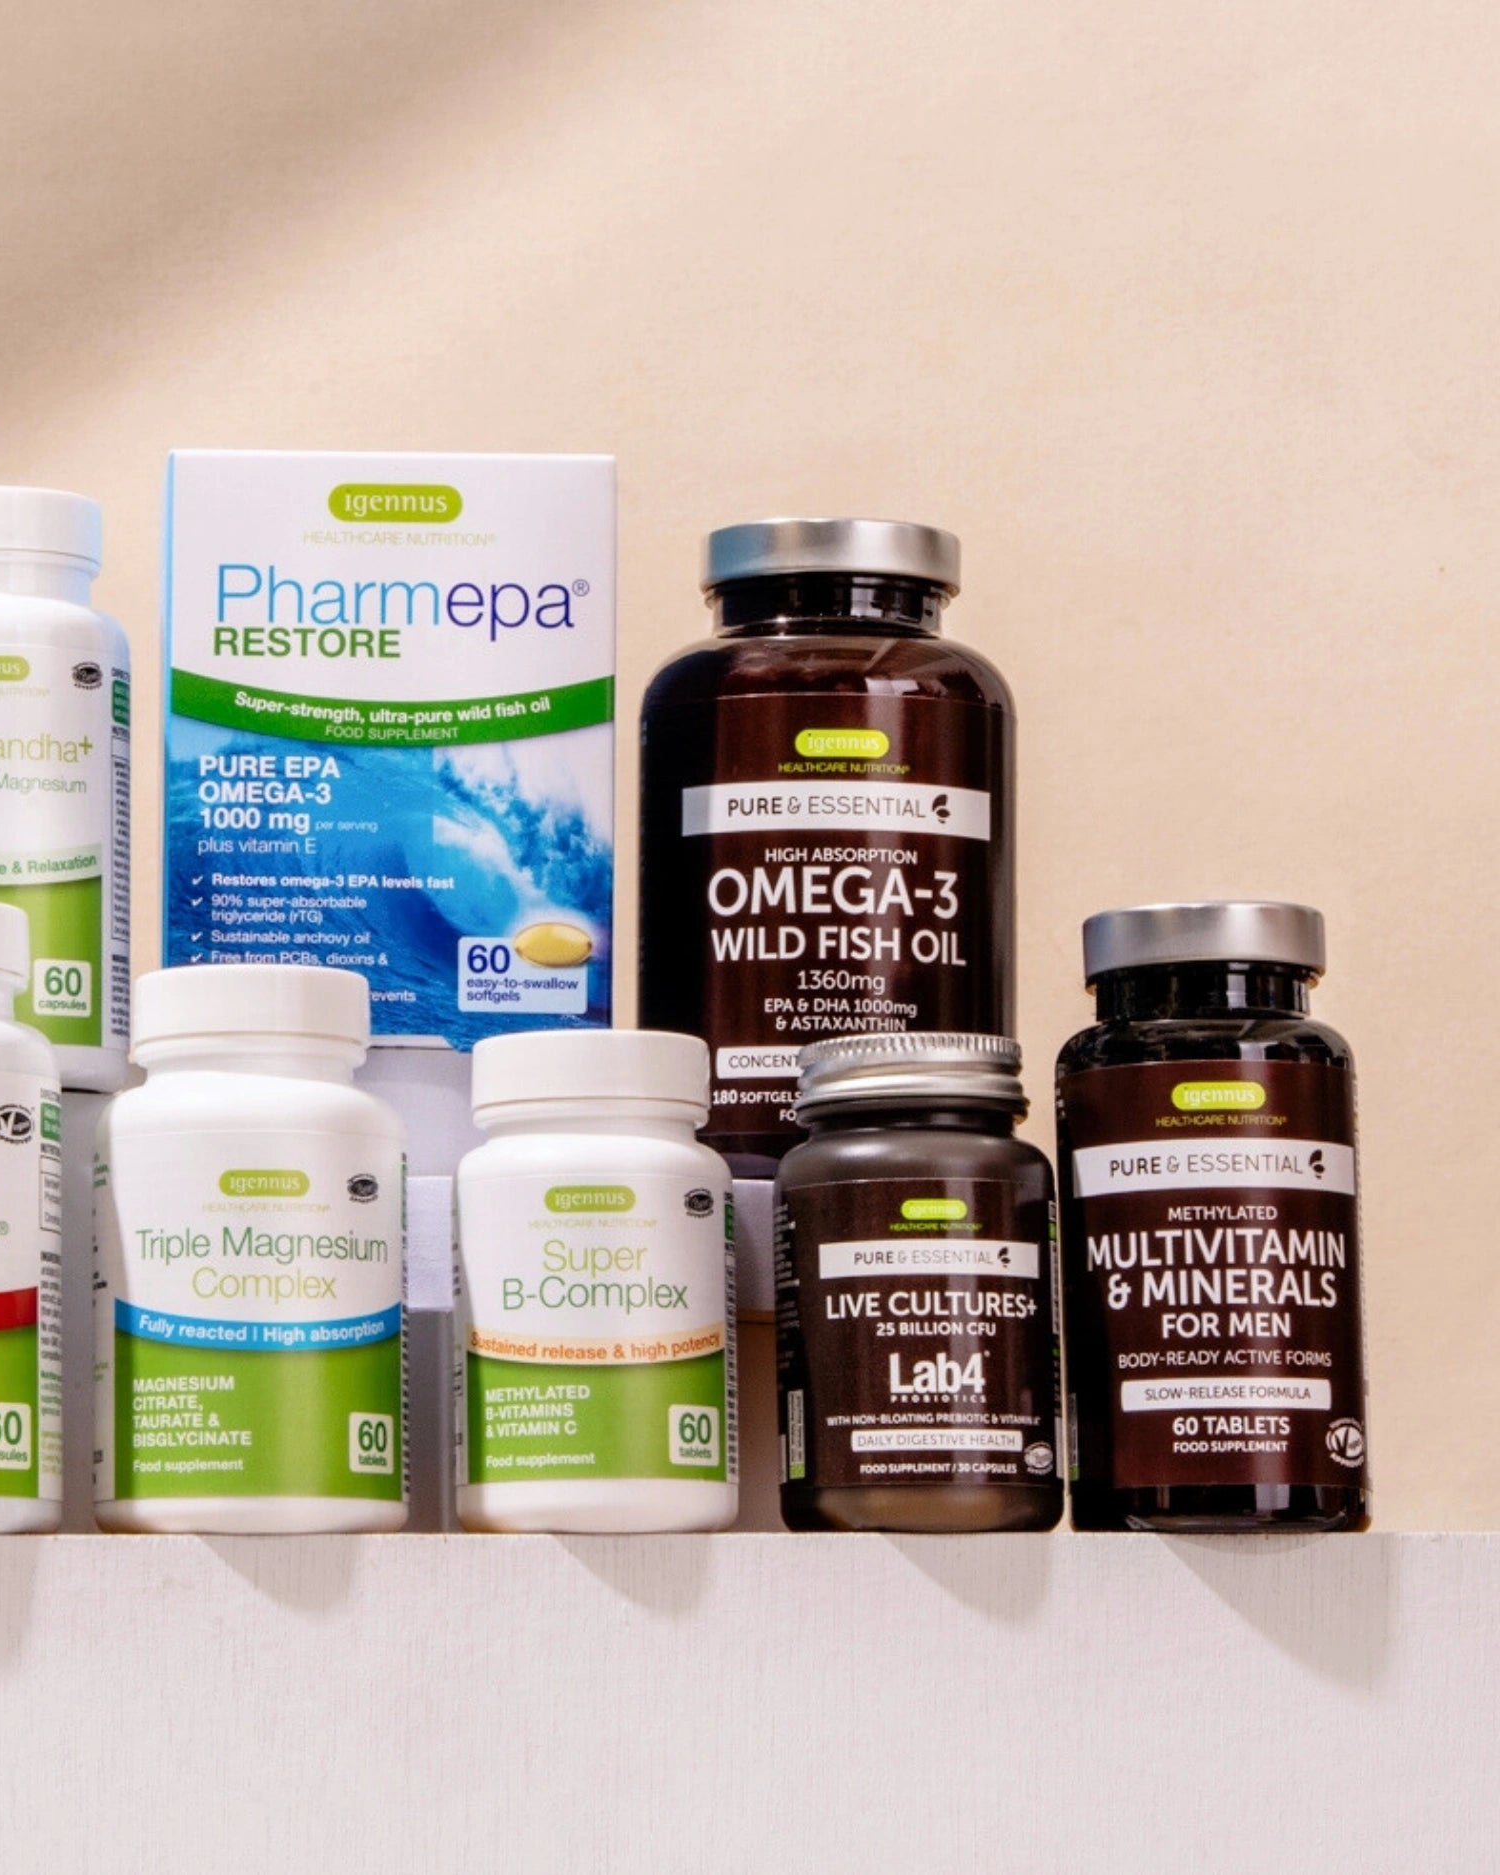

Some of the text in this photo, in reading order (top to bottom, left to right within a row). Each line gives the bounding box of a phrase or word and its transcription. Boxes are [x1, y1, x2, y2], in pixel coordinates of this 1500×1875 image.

[345, 490, 448, 516] igennus
[213, 628, 400, 658] RESTORE
[457, 696, 550, 720] wild fish oil
[326, 726, 458, 739] FOOD SUPPLEMENT
[200, 755, 340, 778] PURE EPA
[199, 781, 331, 804] OMEGA-3
[728, 796, 926, 818] PURE ESSENTIAL
[200, 808, 310, 834] 1000 mg
[198, 838, 298, 855] plus vitamin
[28, 854, 97, 873] Relaxation
[765, 848, 918, 864] HIGH ABSORPTION
[212, 874, 455, 889] Restores EPA levels fast
[708, 867, 959, 919] OMEGA-3
[247, 896, 366, 910] super-absorbable
[212, 910, 285, 924] triglyceride
[212, 930, 349, 946] Sustainable anchovy
[711, 928, 966, 966] WILD FISH OIL
[467, 944, 510, 974] 60
[45, 967, 82, 997] 60
[467, 976, 578, 991] easy-to-swallow
[797, 970, 886, 995] 1360mg
[38, 1000, 87, 1011] capsules
[467, 989, 521, 1004] softgels
[764, 999, 849, 1013] EPA DHA
[791, 1017, 906, 1032] ASTAXANTHIN
[712, 1090, 738, 1105] 180
[1110, 1154, 1303, 1177] PURE ESSENTIAL
[1168, 1206, 1278, 1222] METHYLATED
[136, 1227, 389, 1265] Triple Magnesium
[1087, 1228, 1346, 1272] MULTIVITAMIN
[543, 1239, 648, 1278] Super
[854, 1252, 893, 1265] PURE
[192, 1268, 338, 1305] Complex
[503, 1276, 689, 1315] B-Complex
[1141, 1268, 1338, 1308] MINERALS
[826, 1293, 881, 1319] LIVE
[139, 1315, 384, 1345] Fully reacted High absorption
[876, 1322, 996, 1337] 25 BILLION CFU
[1162, 1312, 1291, 1339] FOR MEN
[542, 1334, 720, 1361] release high potency
[1119, 1350, 1332, 1368] BODY-READY ACTIVE FORMS
[133, 1375, 234, 1393] MAGNESIUM
[485, 1385, 590, 1402] METHYLATED
[1145, 1387, 1311, 1401] SLOW-RELEASE FORMULA
[485, 1403, 574, 1420] B-VITAMINS
[853, 1414, 934, 1425] NON-BLOATING
[133, 1413, 203, 1429] TAURATE
[497, 1422, 560, 1438] VITAMIN
[679, 1413, 712, 1445] 60
[1172, 1416, 1290, 1435] 60 TABLETS
[358, 1421, 388, 1453] 60
[970, 1435, 1016, 1446] HEALTH
[1173, 1440, 1288, 1453] FOOD SUPPLEMENT
[972, 1463, 1017, 1474] CAPSULES
